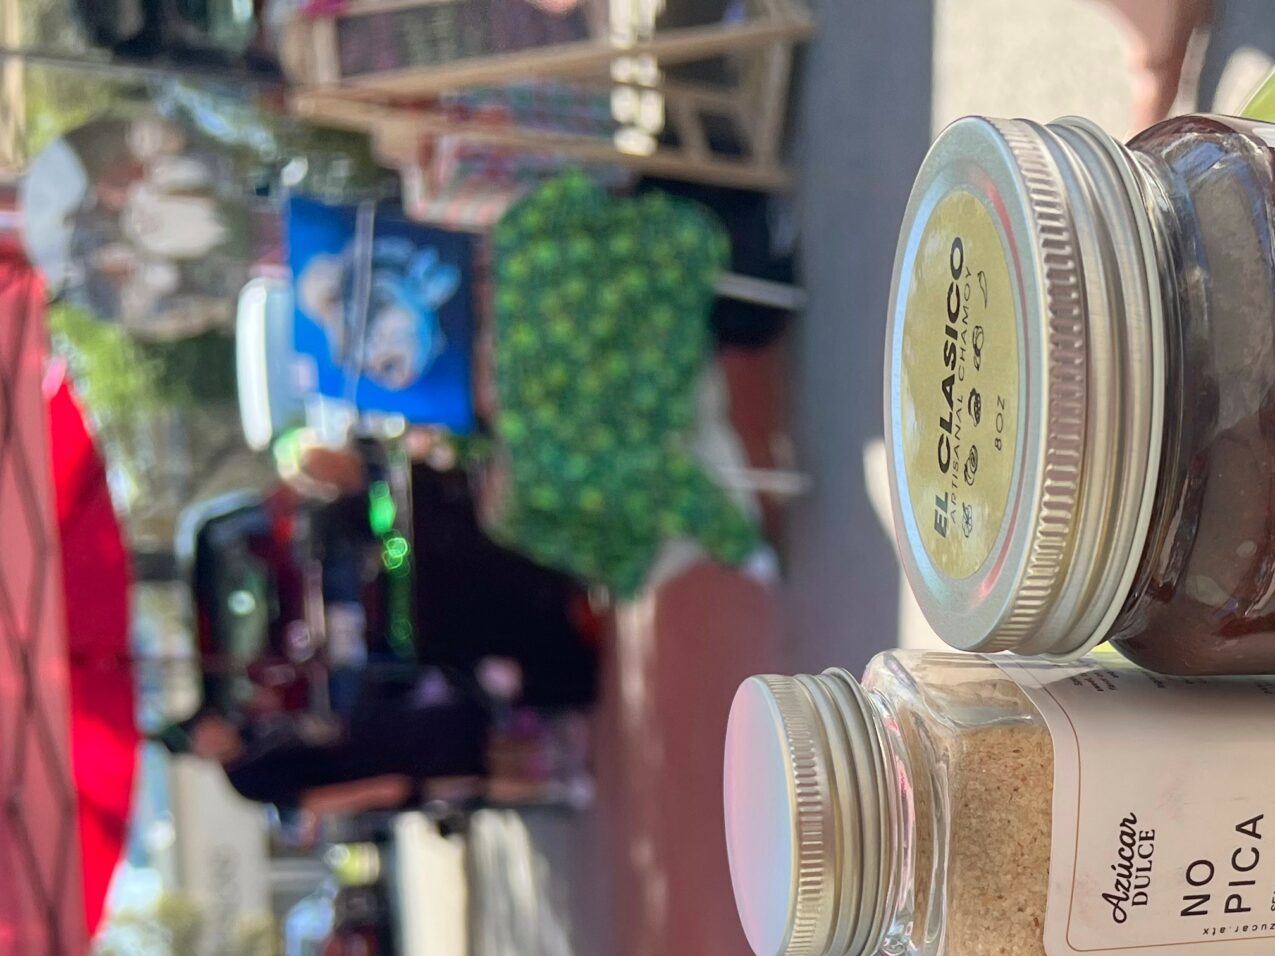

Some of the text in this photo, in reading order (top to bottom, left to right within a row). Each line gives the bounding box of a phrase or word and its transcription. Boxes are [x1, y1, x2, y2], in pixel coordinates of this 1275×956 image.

[933, 235, 964, 538] EL CLASICO
[950, 264, 972, 523] ARTISANAL CHAMOY
[1101, 811, 1137, 923] Azúcar
[1131, 828, 1155, 906] DULCE
[1180, 858, 1215, 916] NO
[1223, 813, 1264, 912] PICA
